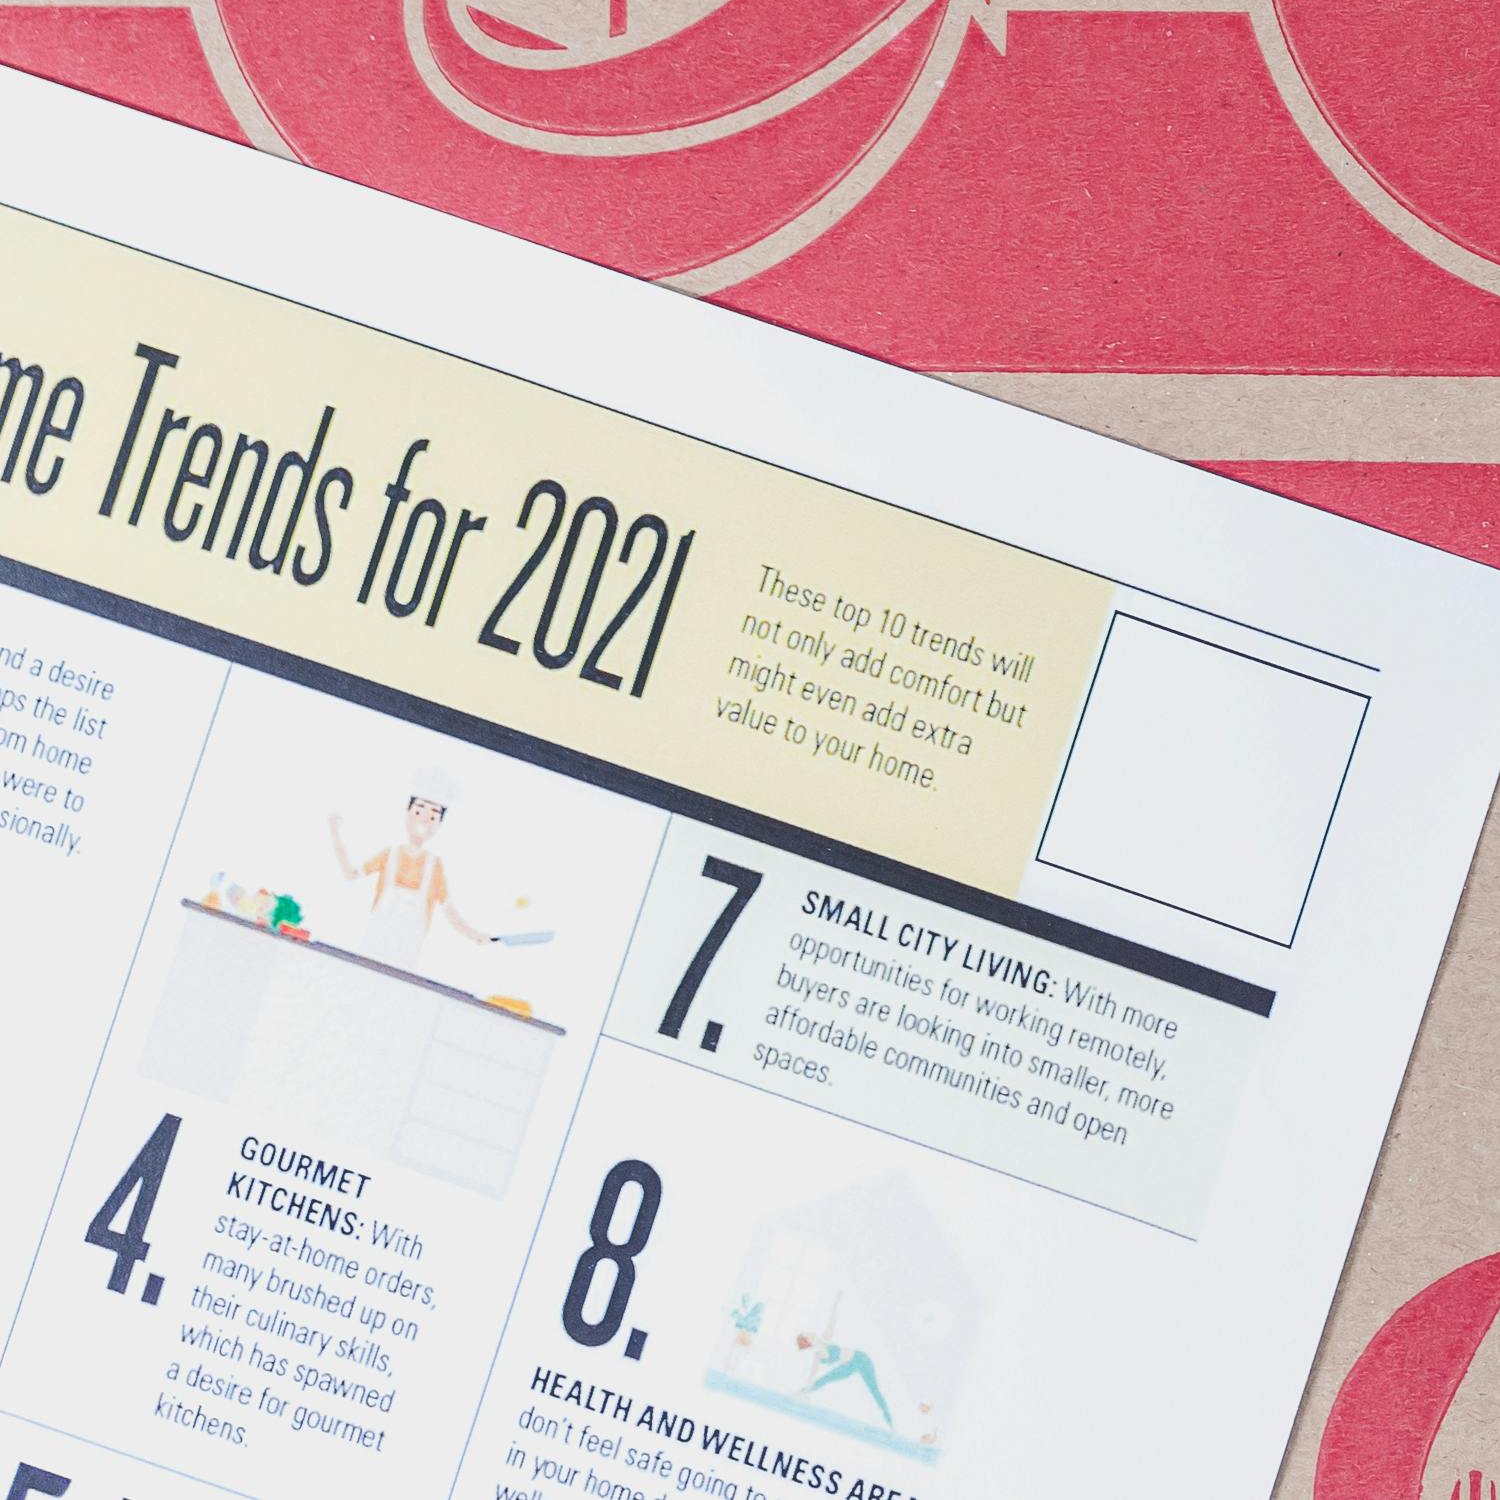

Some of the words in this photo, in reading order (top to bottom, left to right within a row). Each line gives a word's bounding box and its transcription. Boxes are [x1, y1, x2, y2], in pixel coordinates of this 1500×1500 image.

[0, 353, 84, 495] me
[99, 343, 353, 586] Trends
[357, 439, 487, 627] for
[478, 480, 695, 697] 2021
[759, 564, 826, 612] These
[834, 596, 871, 632] top
[881, 609, 907, 638] 10
[911, 622, 984, 666] trends
[992, 652, 1035, 683] will
[0, 687, 27, 712] ps
[33, 696, 67, 725] the
[73, 707, 107, 739] list
[29, 659, 43, 676] a
[48, 661, 114, 700] desire
[728, 655, 797, 695] might
[801, 682, 857, 715] even
[862, 701, 909, 732] add
[911, 719, 973, 755] extra
[742, 615, 782, 644] not
[787, 631, 836, 666] only
[840, 648, 887, 678] add
[889, 666, 984, 712] comfort
[986, 690, 1027, 728] but
[32, 734, 92, 774] home
[718, 697, 778, 735] value
[784, 717, 807, 744] to
[813, 731, 865, 764] your
[868, 742, 936, 791] home.
[3, 771, 57, 803] were
[64, 788, 84, 812] to
[658, 855, 763, 1052] 7.
[801, 890, 889, 941] SMALL
[897, 922, 959, 961] CITY
[962, 944, 1057, 998] LIVING:
[1065, 978, 1117, 1018] With
[1121, 1006, 1177, 1039] more
[777, 963, 850, 1008] buyers
[855, 997, 891, 1022] are
[897, 1004, 976, 1057] looking
[980, 1032, 1023, 1068] into
[1028, 1056, 1109, 1102] smaller,
[1117, 1087, 1174, 1120] more
[790, 933, 934, 996] opportunities
[940, 978, 970, 1008] for
[976, 996, 1063, 1047] working
[1068, 1028, 1165, 1081] remotely,
[753, 1043, 832, 1085] spaces.
[765, 1005, 878, 1059] affordable
[883, 1047, 1022, 1109] communities
[1026, 1097, 1071, 1125] and
[1073, 1113, 1127, 1146] open
[85, 1113, 182, 1304] 4.
[240, 1136, 371, 1199] GOURMET
[226, 1171, 364, 1240] KITCHENS:
[372, 1220, 423, 1260] With
[562, 1160, 662, 1360] 8.
[203, 1252, 263, 1291] many
[266, 1267, 356, 1318] brushed
[360, 1306, 386, 1334] up
[392, 1318, 418, 1341] on
[215, 1216, 359, 1279] stay-at-home
[365, 1267, 435, 1310] orders,
[181, 1324, 244, 1361] which
[249, 1342, 288, 1376] has
[293, 1364, 396, 1413] spawned
[192, 1285, 242, 1319] their
[246, 1309, 332, 1357] culinary
[335, 1337, 392, 1377] skills,
[155, 1392, 247, 1447] kitchens.
[166, 1363, 180, 1380] a
[186, 1364, 252, 1405] desire
[259, 1387, 290, 1417] for
[291, 1406, 385, 1451] gourmet
[518, 1406, 574, 1445] don't
[579, 1425, 622, 1460] feel
[625, 1448, 673, 1479] safe
[530, 1366, 634, 1422] HEALTH
[635, 1404, 695, 1443] AND
[701, 1425, 842, 1495] WELLNESS
[506, 1441, 526, 1469] in
[532, 1456, 581, 1487] your
